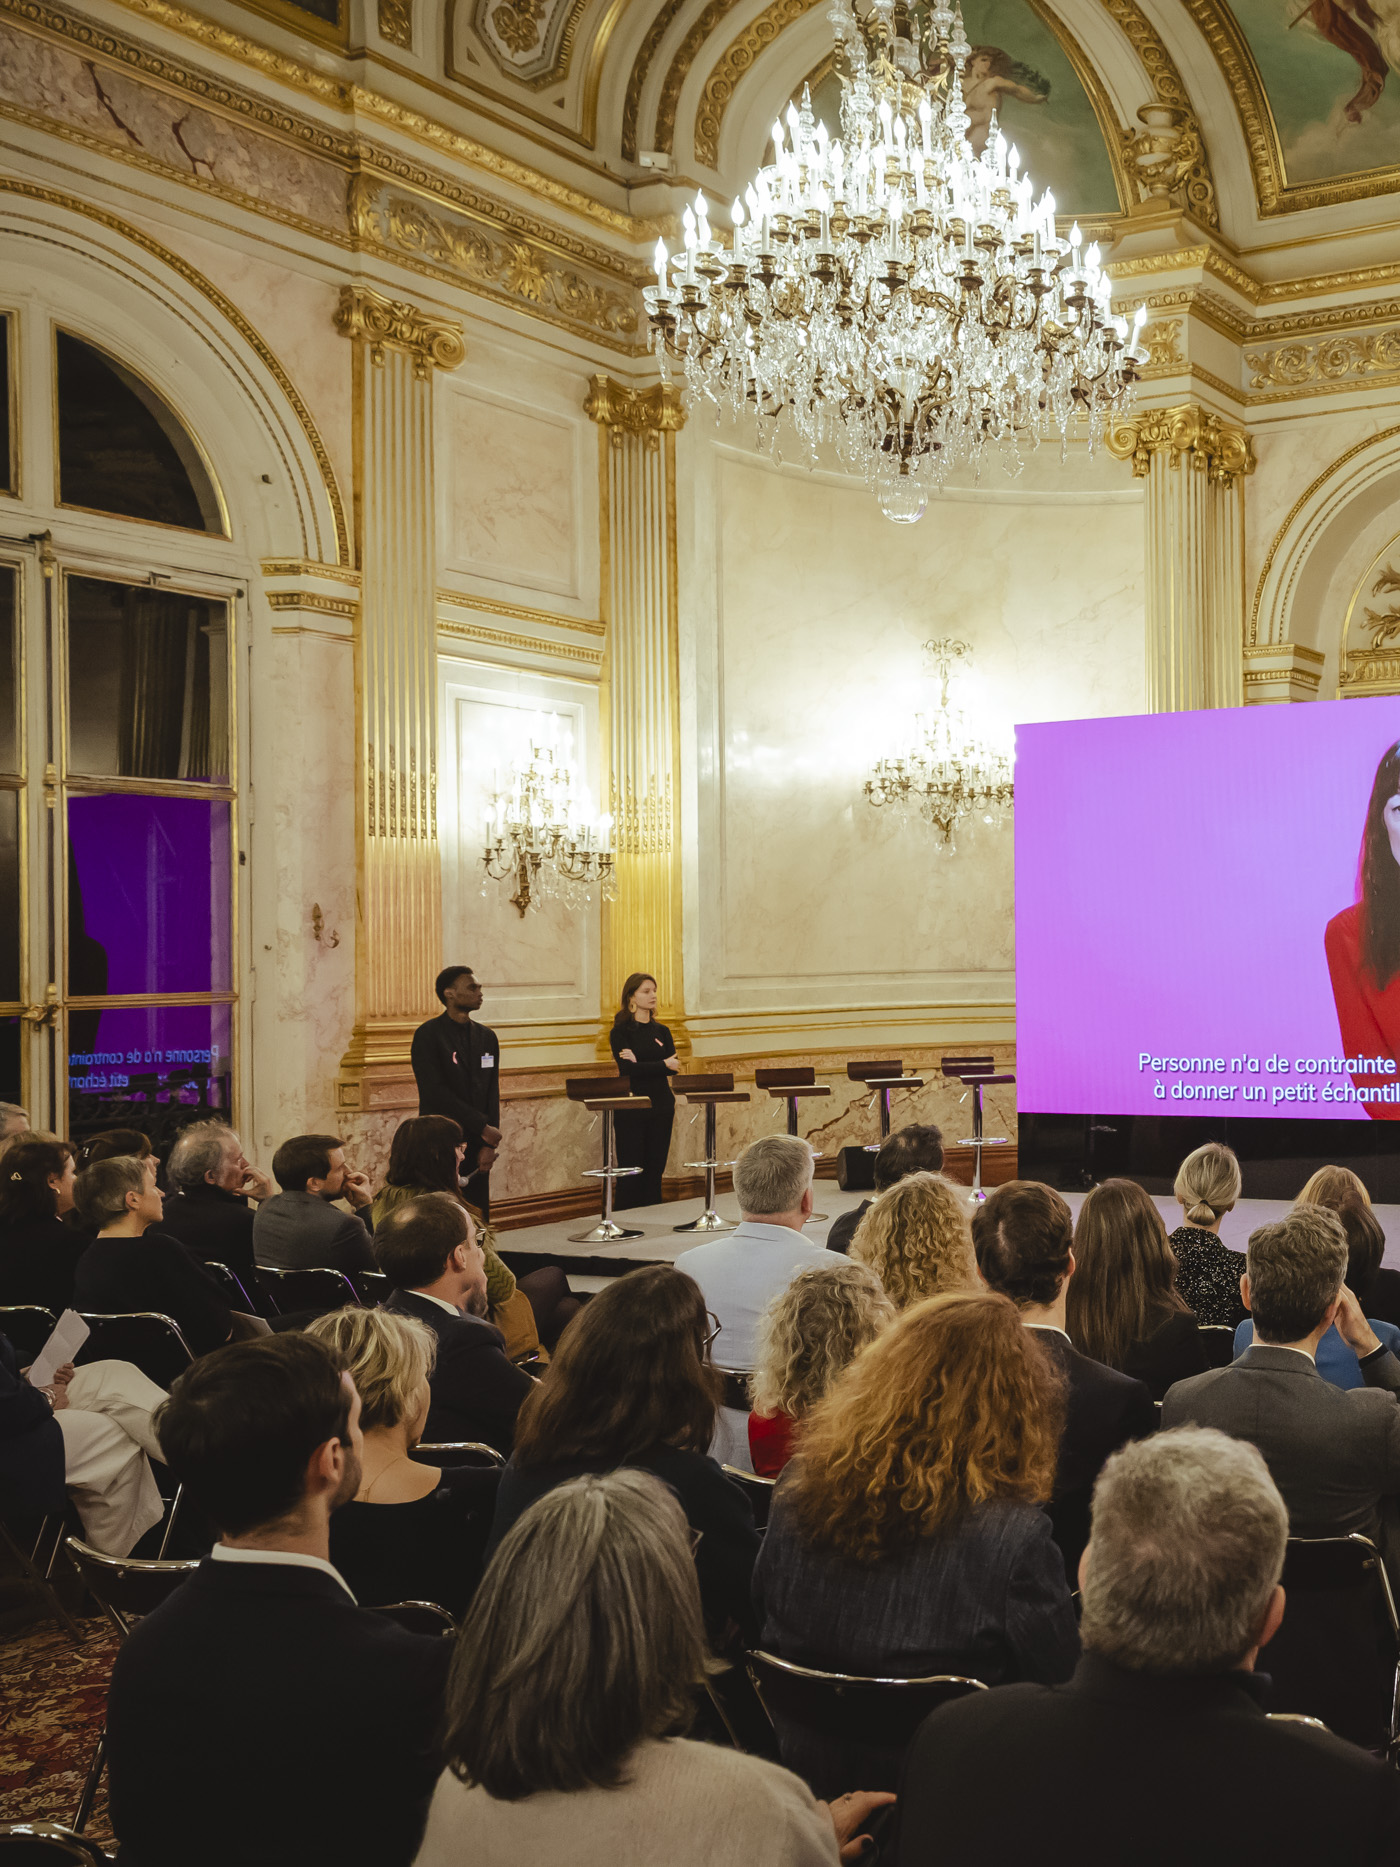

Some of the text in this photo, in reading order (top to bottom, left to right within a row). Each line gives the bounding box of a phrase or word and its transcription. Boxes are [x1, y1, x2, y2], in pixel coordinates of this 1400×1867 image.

[1139, 1052, 1226, 1073] Personne
[1230, 1053, 1260, 1073] n'a
[1265, 1053, 1290, 1073] de
[1294, 1054, 1396, 1074] contrainte
[1153, 1079, 1166, 1099] à
[1170, 1080, 1237, 1100] donner
[1242, 1086, 1266, 1100] un
[1272, 1082, 1316, 1105] petit
